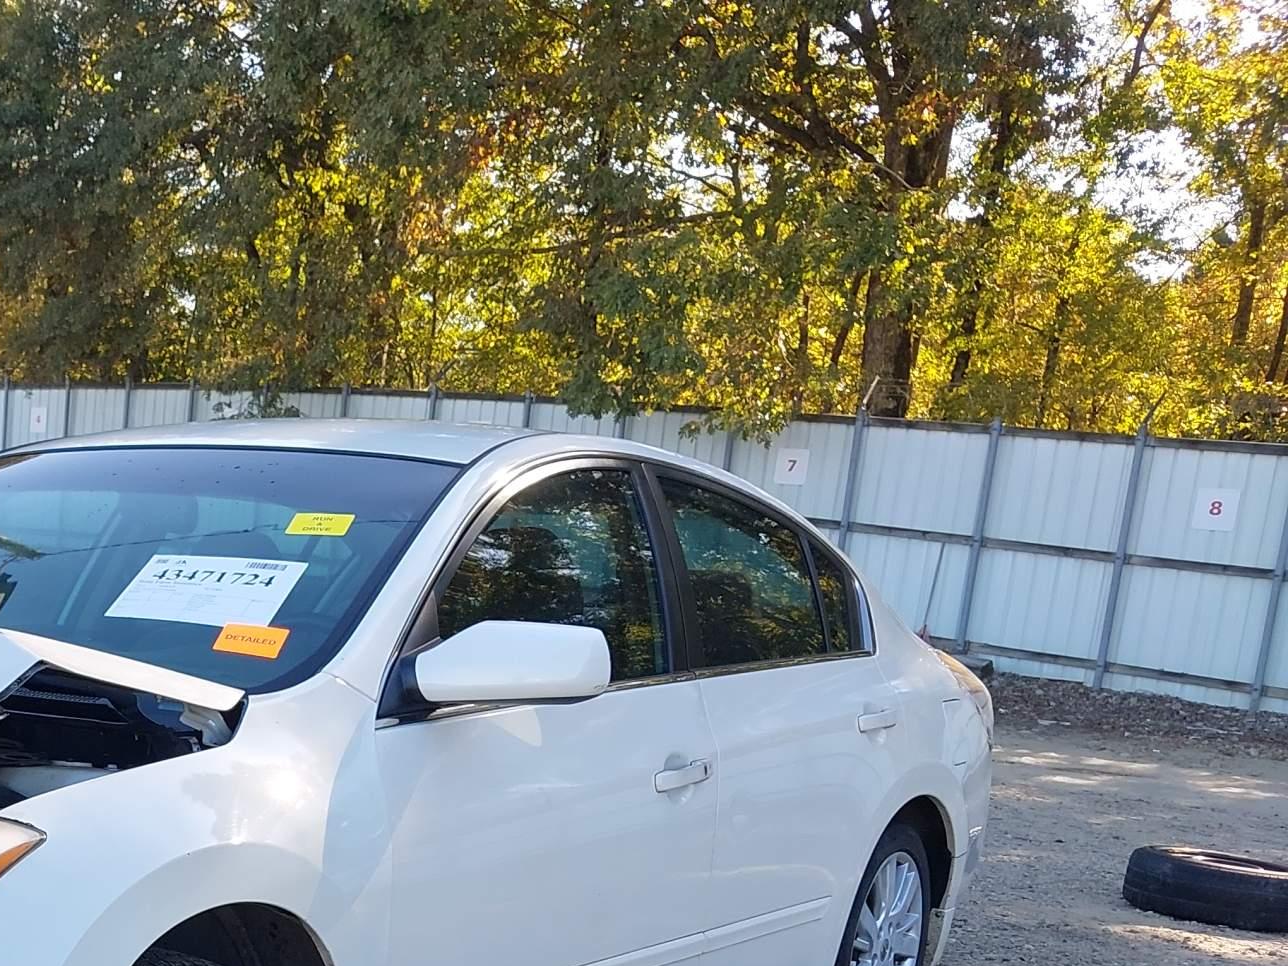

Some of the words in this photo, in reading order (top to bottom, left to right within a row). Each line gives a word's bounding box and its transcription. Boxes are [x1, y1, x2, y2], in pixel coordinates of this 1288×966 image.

[788, 459, 797, 472] 7
[1209, 500, 1222, 515] 8
[152, 568, 277, 588] 43471724
[225, 633, 277, 646] DETAILED
